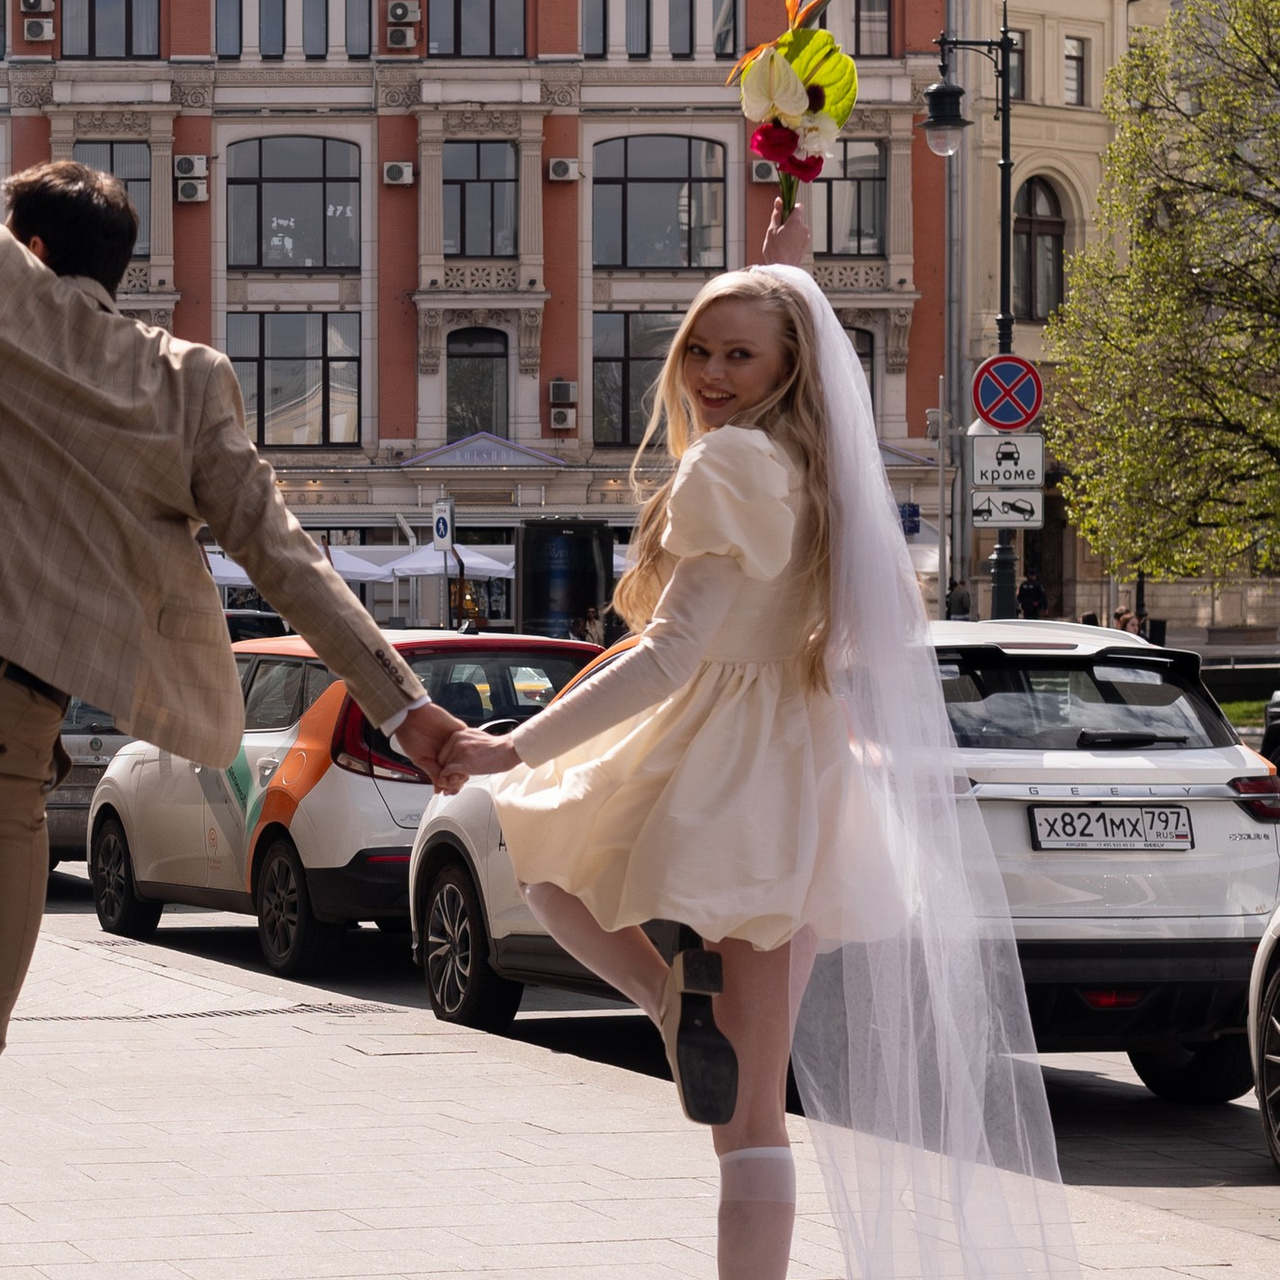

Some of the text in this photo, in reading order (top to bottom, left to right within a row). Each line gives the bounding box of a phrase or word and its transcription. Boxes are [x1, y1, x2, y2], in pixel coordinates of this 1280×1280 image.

[980, 469, 1036, 485] кроме
[1028, 786, 1192, 796] GEELY
[1144, 811, 1181, 831] 797
[1155, 830, 1174, 840] RUS
